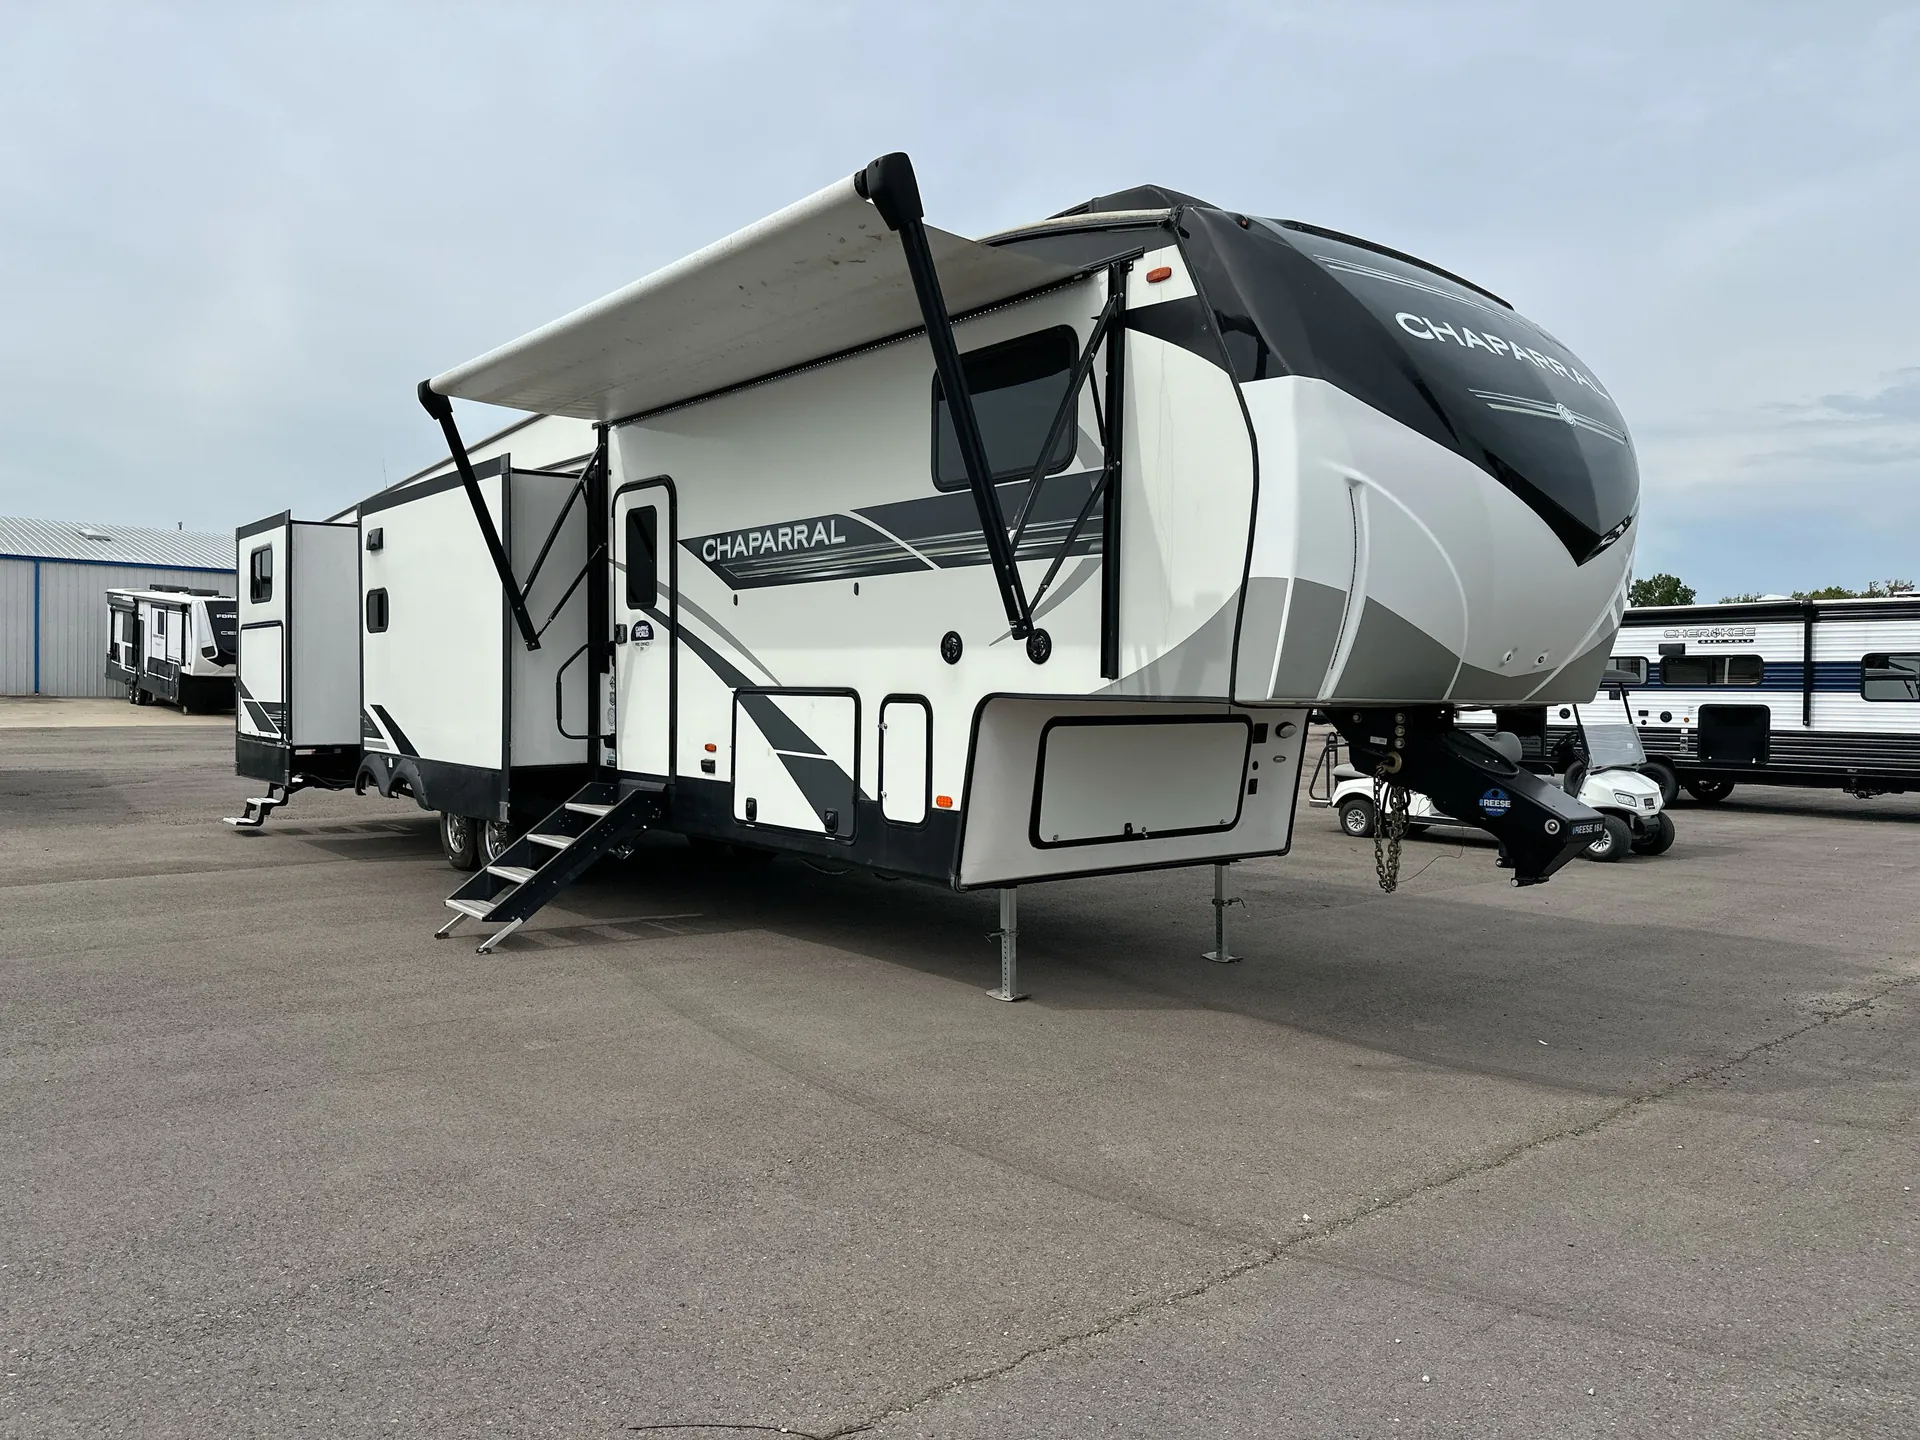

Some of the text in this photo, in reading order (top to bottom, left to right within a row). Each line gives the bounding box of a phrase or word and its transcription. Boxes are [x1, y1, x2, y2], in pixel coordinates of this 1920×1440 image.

[1395, 312, 1610, 400] CHAPARRAL
[702, 519, 846, 562] CHAPARRAL
[1664, 627, 1756, 638] CHEROKEE
[1483, 799, 1511, 808] REESE
[1576, 824, 1594, 834] REESE
